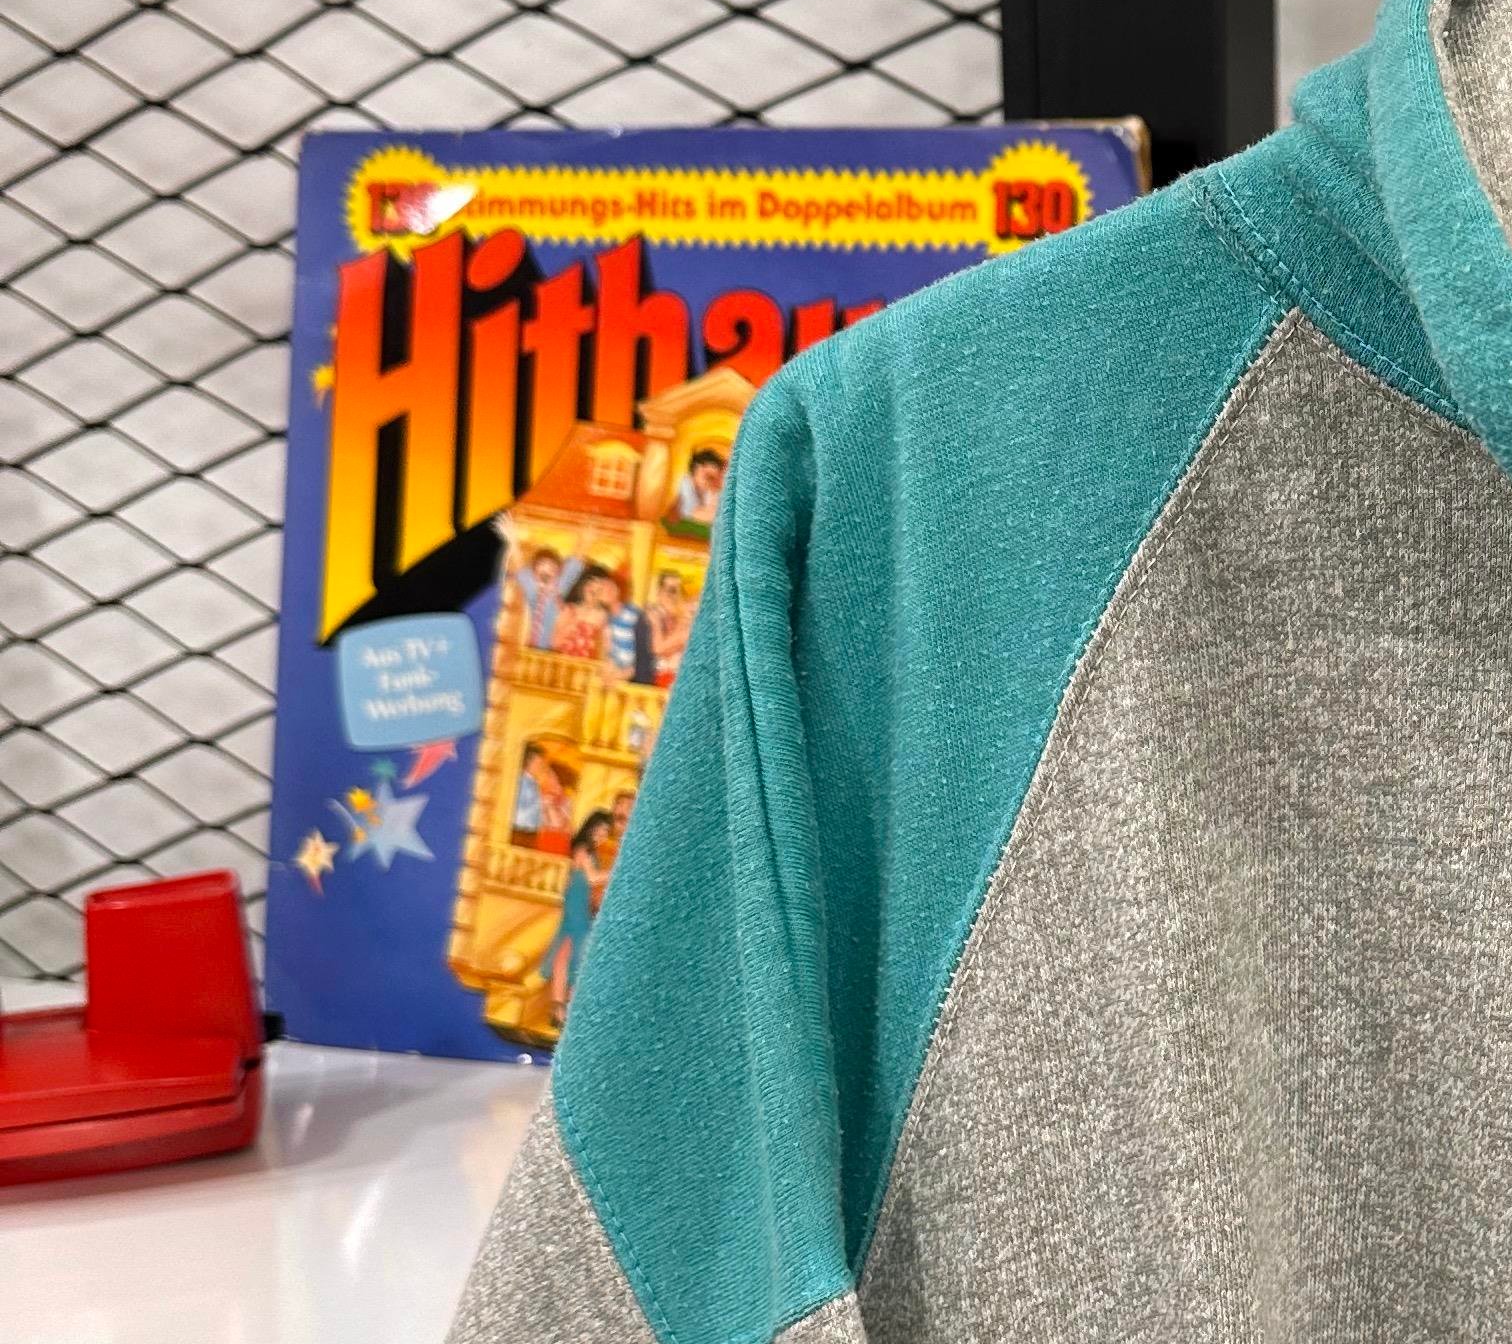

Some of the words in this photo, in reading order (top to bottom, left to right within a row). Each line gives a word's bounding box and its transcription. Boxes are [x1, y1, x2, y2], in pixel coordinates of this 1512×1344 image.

[465, 187, 697, 229] immungs-Hits
[707, 186, 748, 220] im
[757, 191, 979, 230] Doppelalbum
[992, 181, 1077, 236] 130
